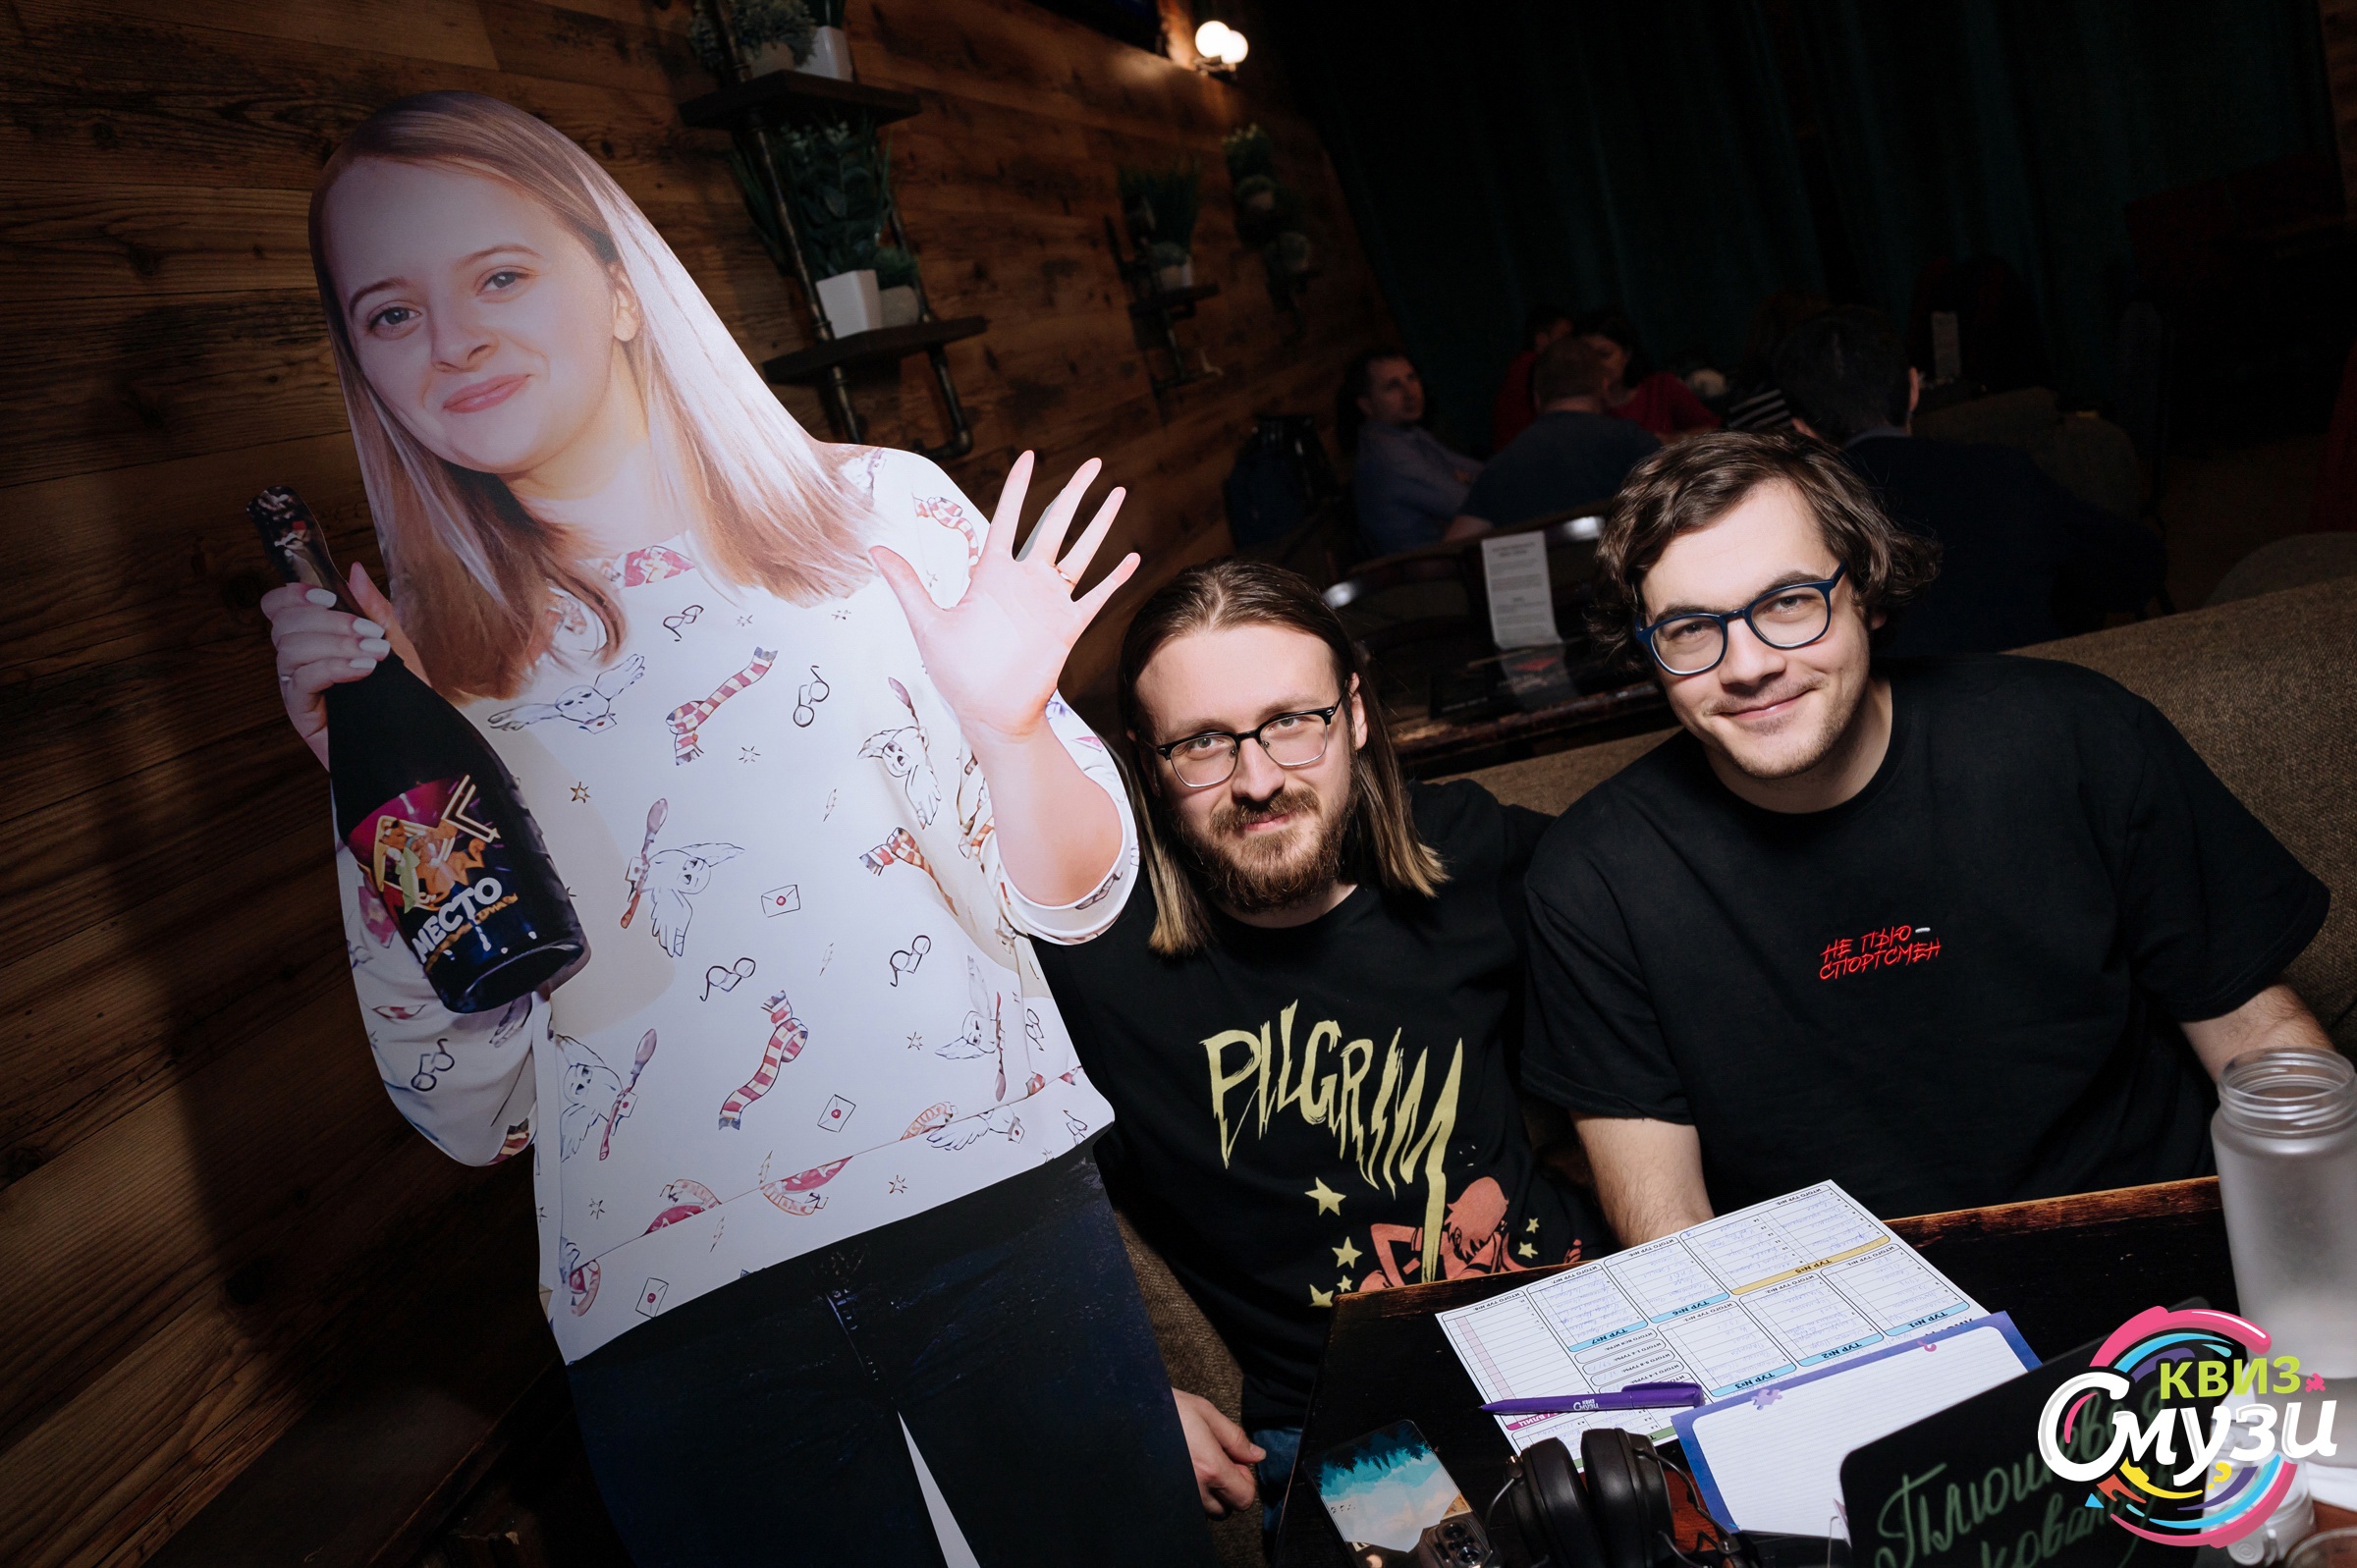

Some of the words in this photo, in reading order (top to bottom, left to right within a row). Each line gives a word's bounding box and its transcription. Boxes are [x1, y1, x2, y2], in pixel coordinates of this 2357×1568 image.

[1820, 939, 1853, 964] НЕ
[1861, 925, 1911, 953] ПЬЮ
[1819, 937, 1942, 980] СПОРТСМЕН
[1199, 999, 1463, 1282] PILGRIM
[1872, 1246, 1894, 1258] ИТОГО
[1814, 1259, 1832, 1269] ТУР
[1576, 1266, 1597, 1275] ИТОГО
[1794, 1266, 1811, 1274] №5
[1791, 1274, 1814, 1285] ИТОГО
[1691, 1300, 1709, 1310] ТУР
[1710, 1303, 1732, 1314] ИТОГО
[1672, 1307, 1689, 1316] №6
[1928, 1311, 1948, 1323] ТУР
[1908, 1319, 1926, 1329] №1
[1609, 1327, 1628, 1338] ТУР
[1633, 1332, 1653, 1341] ИТОГО
[1591, 1334, 1608, 1344] №7
[1641, 1342, 1662, 1352] ИТОГО
[1841, 1341, 1862, 1353] ТУР
[1650, 1353, 1671, 1363] ИТОГО
[1821, 1349, 1839, 1360] №2
[1658, 1365, 1679, 1375] ИТОГО
[1754, 1372, 1775, 1383] ТУР
[1734, 1379, 1752, 1390] №3
